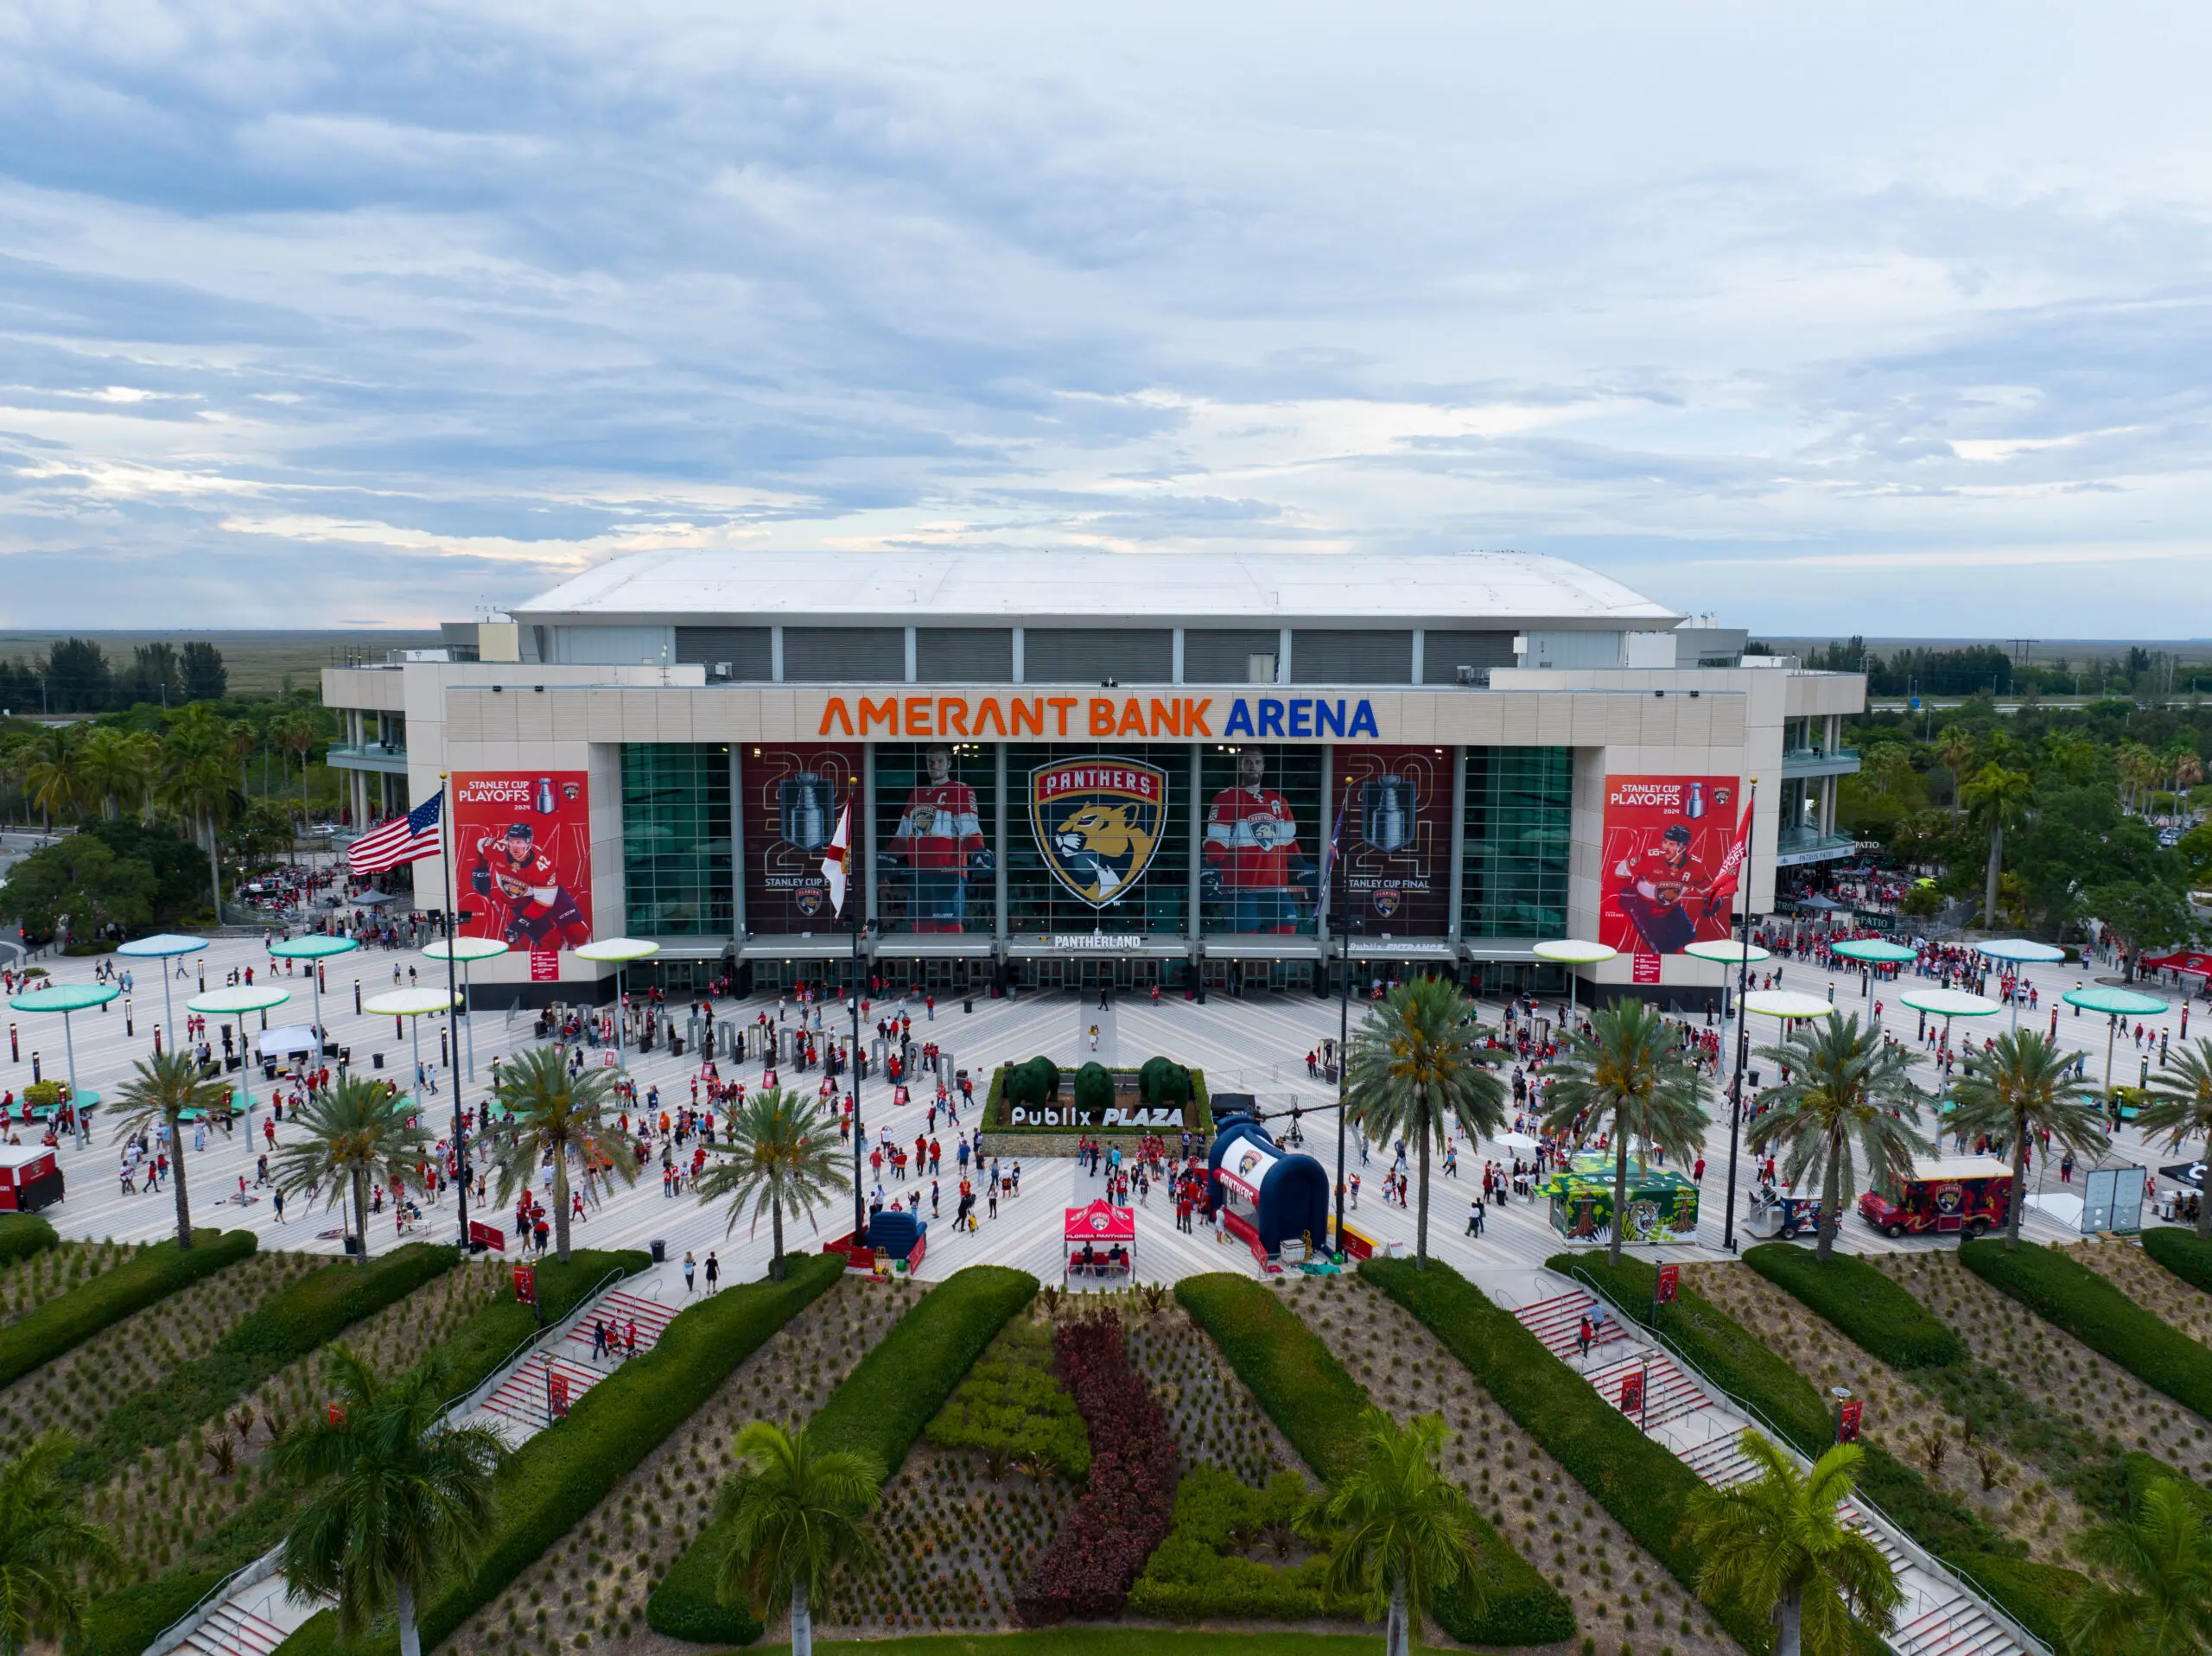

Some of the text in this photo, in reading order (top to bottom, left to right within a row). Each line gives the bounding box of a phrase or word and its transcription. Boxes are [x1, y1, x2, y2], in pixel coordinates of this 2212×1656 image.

[818, 697, 1380, 739] AMERANT BANK ARENA
[469, 781, 530, 790] STANLEY CUP
[1046, 769, 1151, 795] PANTHERS
[1622, 784, 1681, 793] STANLEY CUP
[459, 790, 531, 803] PLAYOFFS
[1611, 793, 1681, 806] PLAYOFFS
[1855, 841, 1879, 849] PATIO
[1820, 851, 1834, 860] PATIO
[536, 855, 551, 872] 42
[766, 878, 803, 886] STANLEY
[805, 878, 823, 886] CUP
[1383, 879, 1401, 888] CUP
[1402, 879, 1430, 888] FINAL
[1860, 916, 1888, 928] PATIO
[1054, 936, 1141, 948] PANTHERLAND
[1011, 1107, 1184, 1126] Publix PLAZA
[1219, 1172, 1254, 1204] PANTHERS
